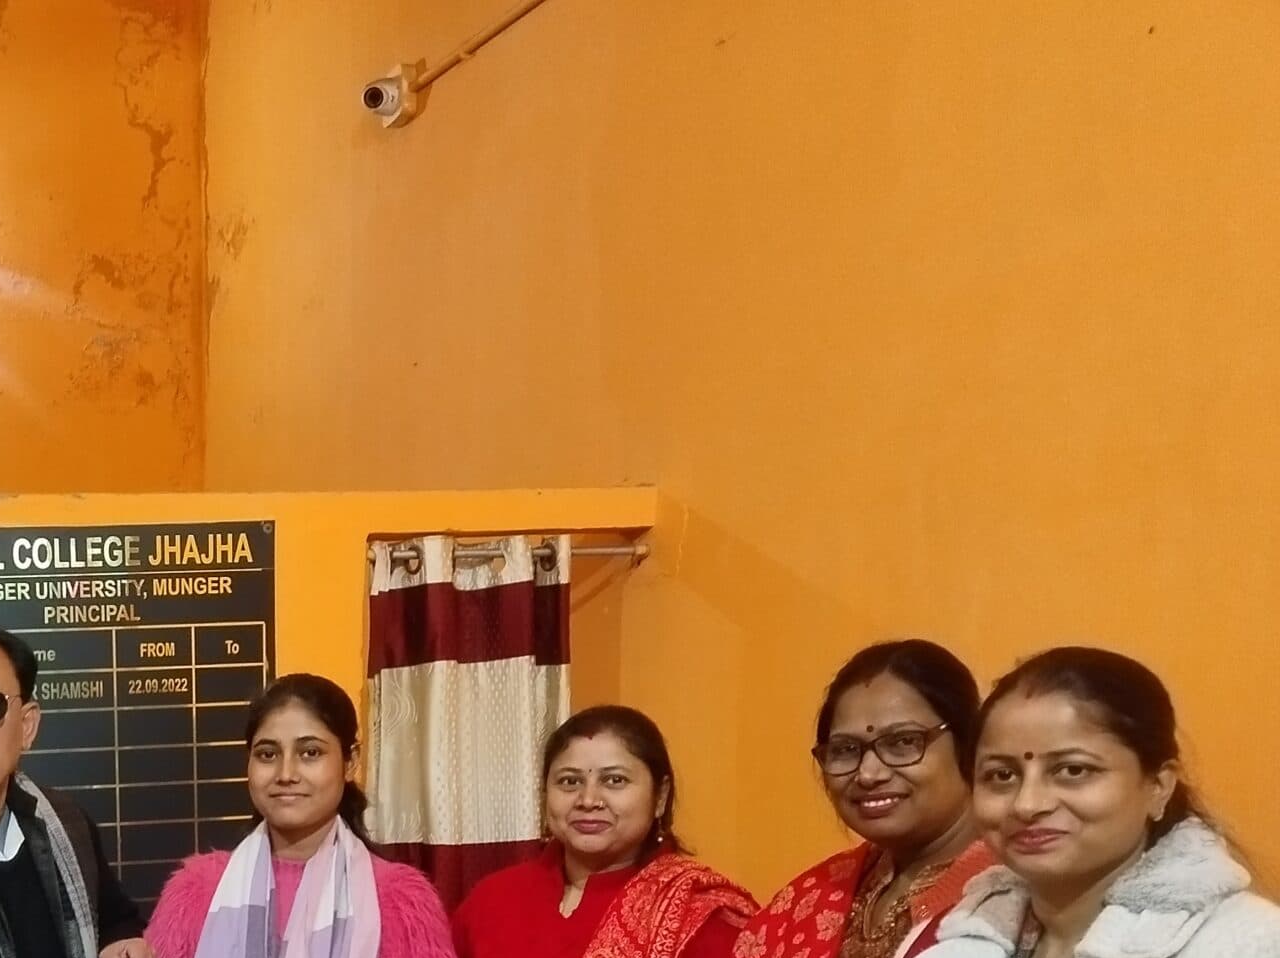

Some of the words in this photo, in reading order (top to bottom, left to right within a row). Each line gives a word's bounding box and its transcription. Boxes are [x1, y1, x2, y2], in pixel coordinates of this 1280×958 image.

[12, 535, 141, 570] COLLEGE
[148, 533, 253, 566] JHAJHA
[35, 579, 148, 600] UNIVERSITY,
[153, 576, 232, 596] MUNGER
[44, 603, 141, 624] PRINCIPAL
[33, 648, 56, 661] me
[140, 641, 175, 657] FROM
[225, 640, 240, 654] To
[41, 680, 104, 700] SHAMSHI
[128, 678, 189, 695] 22.09.2022
